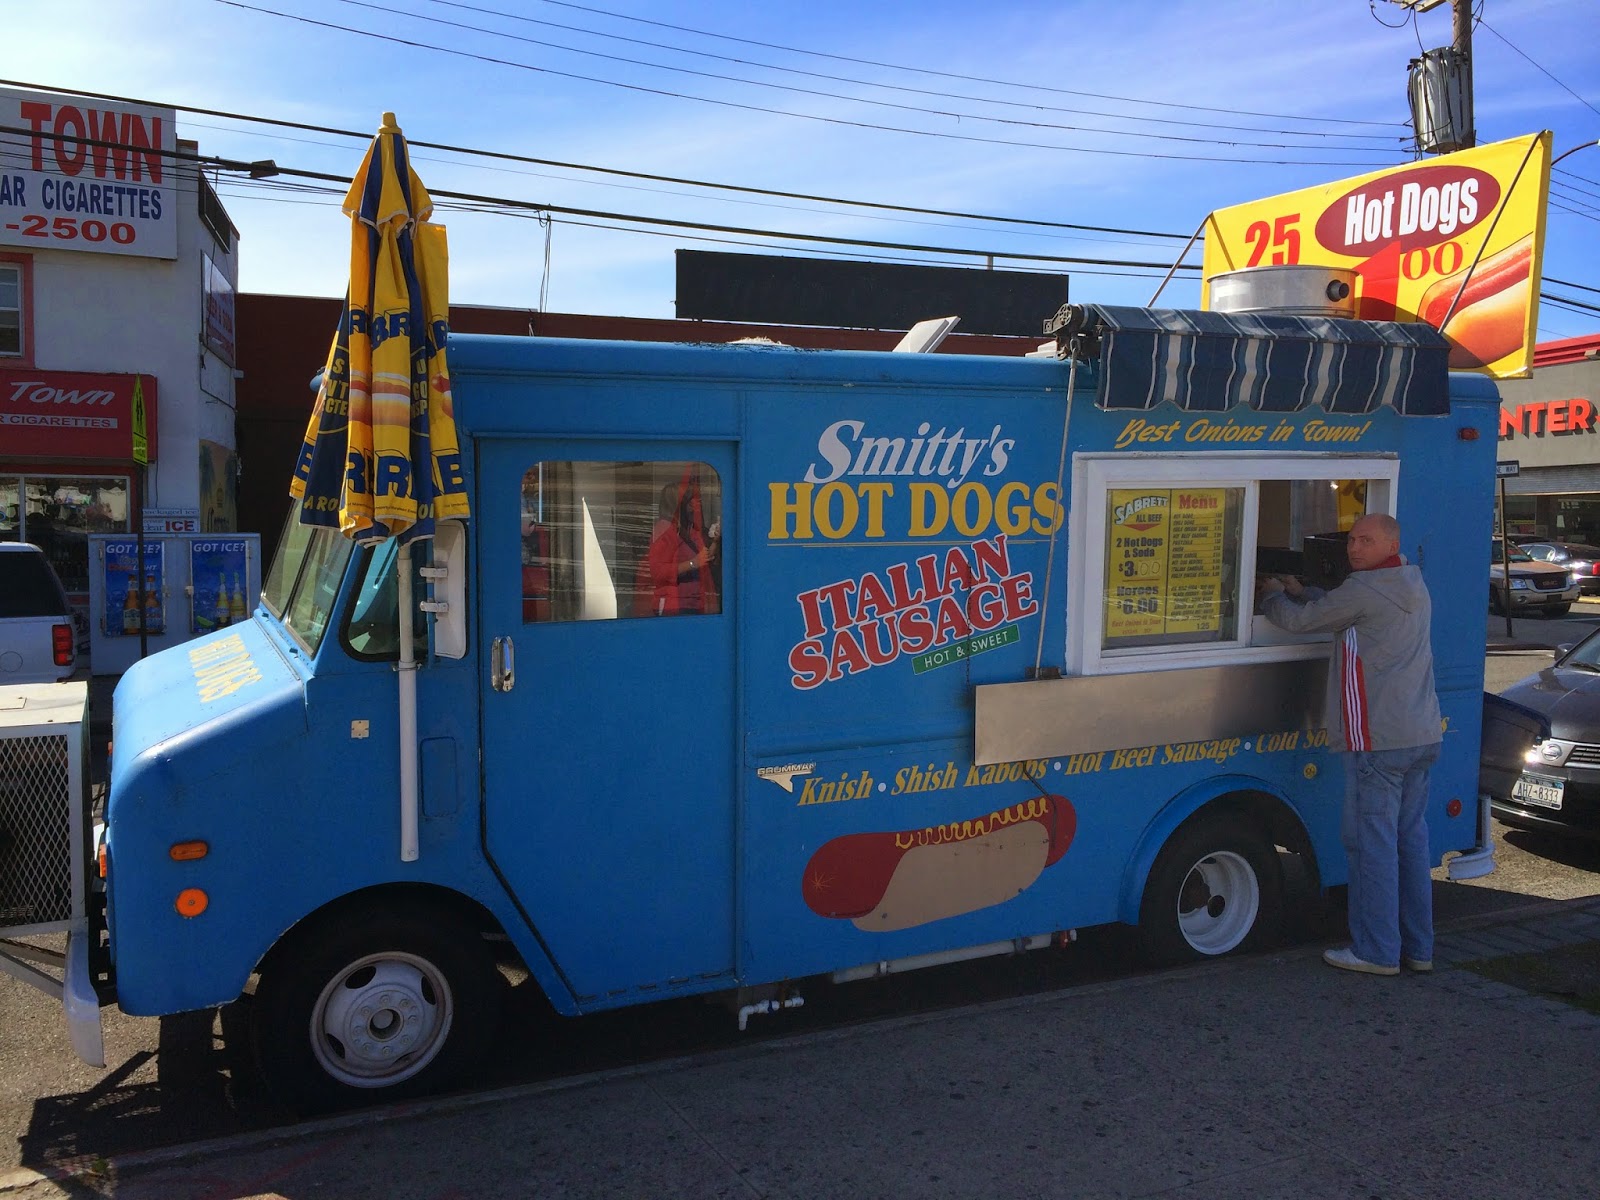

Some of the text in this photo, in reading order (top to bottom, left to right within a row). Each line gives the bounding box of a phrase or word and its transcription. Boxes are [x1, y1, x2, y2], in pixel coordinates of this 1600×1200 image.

[21, 101, 162, 184] TOWN
[42, 179, 162, 220] CIGARETTES
[1344, 177, 1479, 246] Hot Dogs
[5, 215, 136, 244] -2500
[10, 381, 115, 406] Town
[10, 415, 111, 427] CIGARETTES
[1114, 418, 1372, 449] Best Onions in Town!
[803, 420, 1016, 488] Smitty's
[767, 481, 1065, 539] HOT DOGS
[1114, 495, 1169, 525] SABRETT
[1178, 494, 1219, 510] Menu
[165, 520, 195, 532] ICE
[106, 544, 133, 554] GOT
[193, 542, 246, 553] GOT ICE?
[1116, 536, 1163, 548] 2 Hot Dogs
[1133, 547, 1155, 557] Soda
[798, 533, 1011, 640] ITALIAN
[788, 571, 1039, 690] SAUSAGE
[924, 631, 1009, 668] HOT & SWEET
[796, 770, 874, 806] Knish
[891, 761, 959, 796] Shish
[1063, 751, 1106, 776] Hot
[1160, 736, 1241, 764] Sausage
[1255, 730, 1299, 754] Cold
